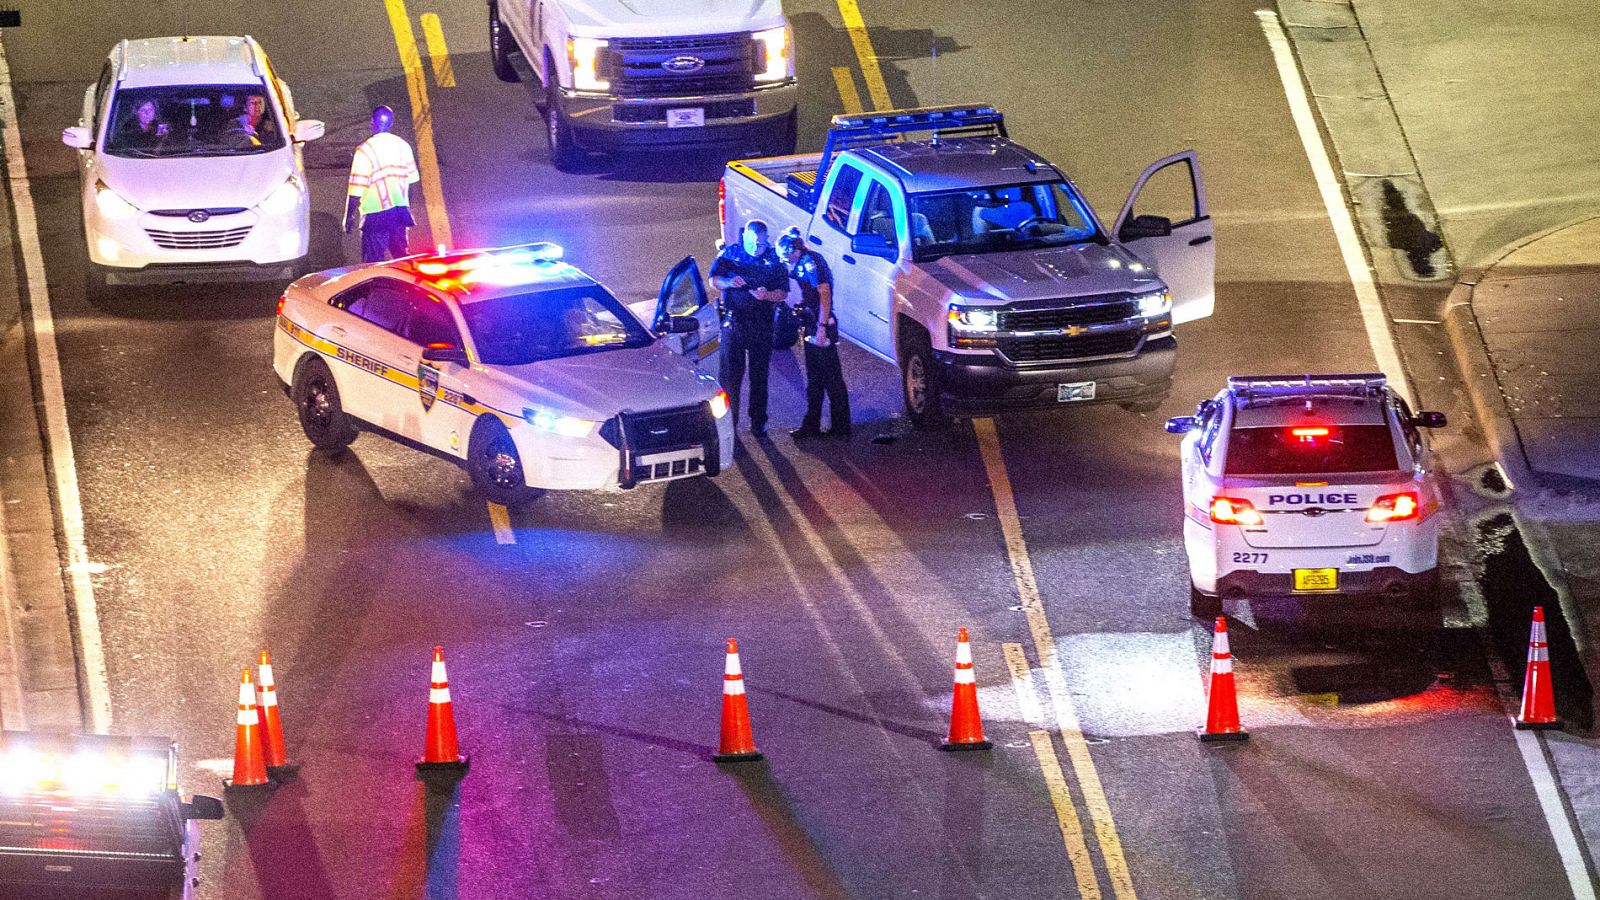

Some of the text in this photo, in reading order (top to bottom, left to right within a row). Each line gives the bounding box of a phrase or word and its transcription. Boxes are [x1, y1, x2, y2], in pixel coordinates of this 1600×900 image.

[337, 347, 388, 375] SHERIFF
[1269, 493, 1358, 505] POLICE
[1233, 552, 1268, 564] 2277
